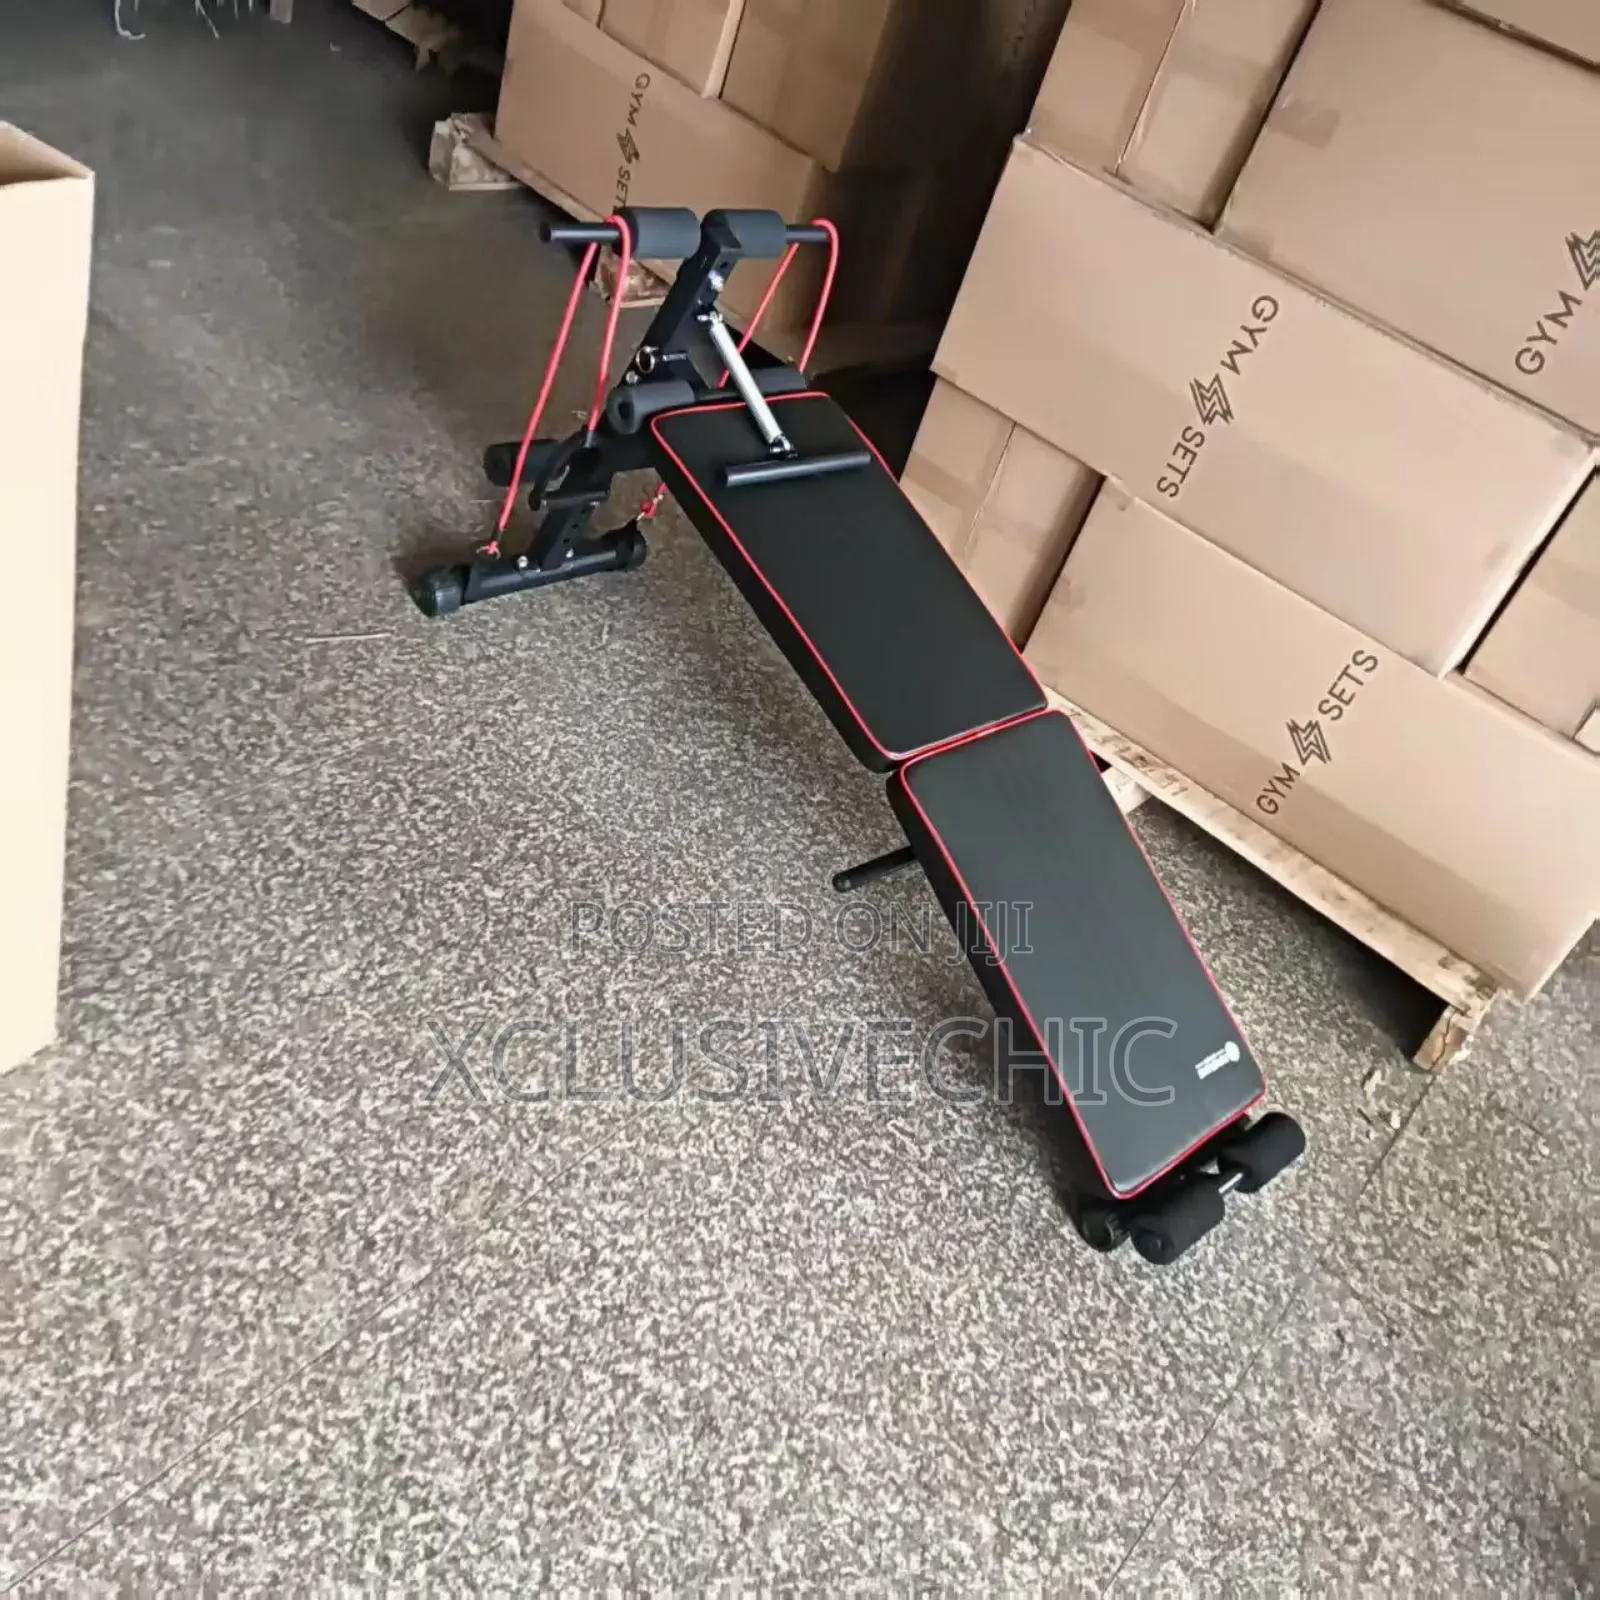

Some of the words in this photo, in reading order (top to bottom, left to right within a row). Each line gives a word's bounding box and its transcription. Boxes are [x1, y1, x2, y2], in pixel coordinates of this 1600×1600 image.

[626, 72, 651, 128] GYM
[611, 165, 631, 215] SET
[1219, 294, 1280, 376] GYM
[1514, 289, 1584, 375] GYM
[1155, 425, 1206, 498] SETS
[1255, 761, 1301, 815] GYM
[1317, 649, 1379, 721] SETS
